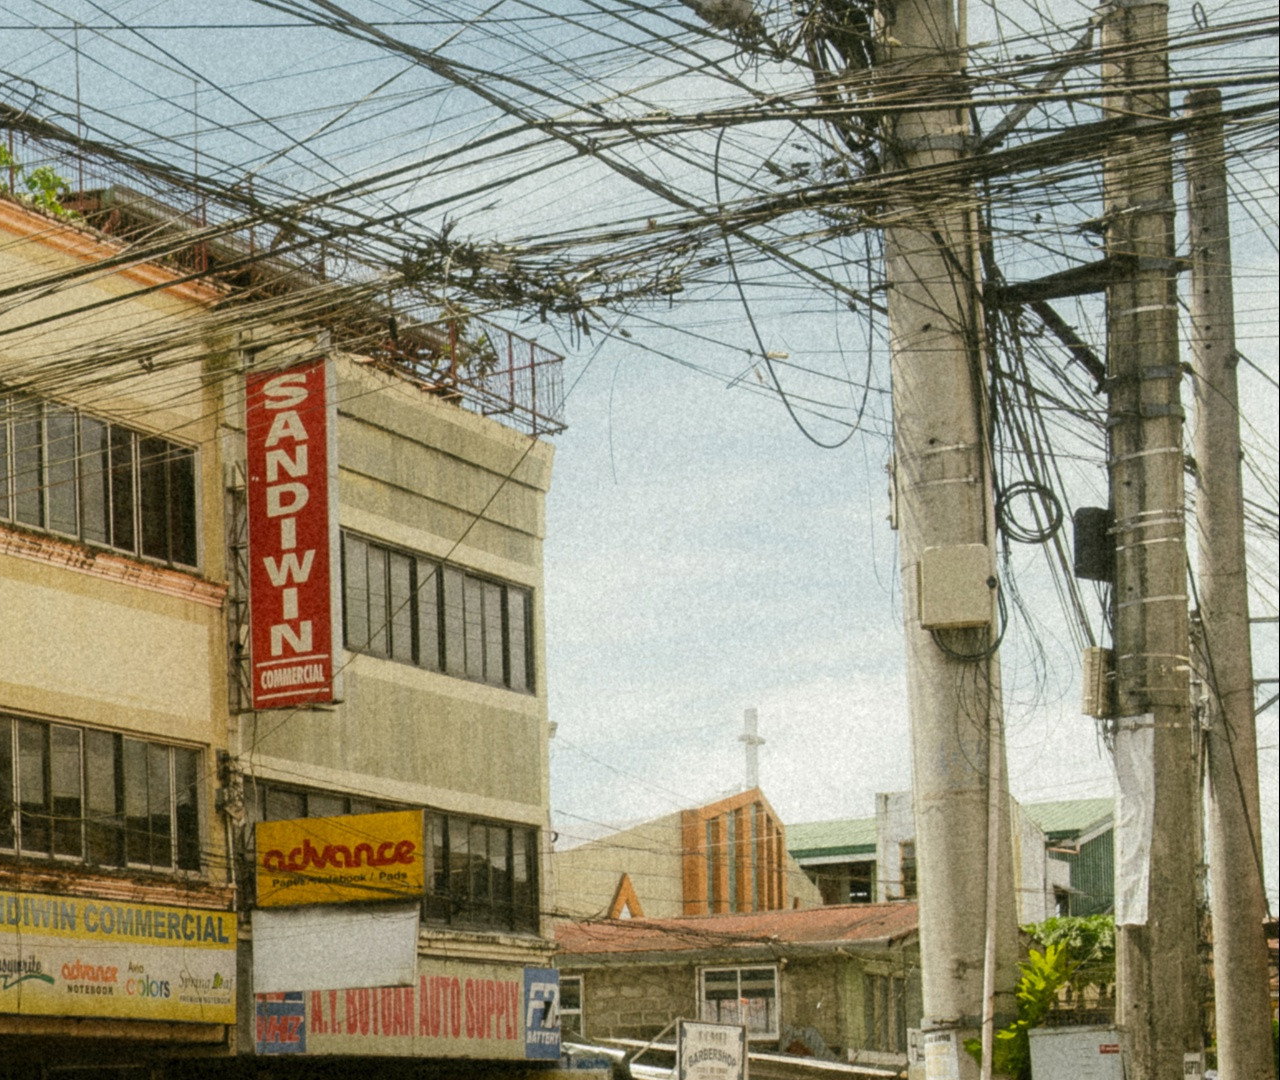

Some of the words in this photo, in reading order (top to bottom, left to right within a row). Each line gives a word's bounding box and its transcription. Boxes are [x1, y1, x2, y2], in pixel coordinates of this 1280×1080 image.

[262, 373, 316, 656] SANDIWIN
[260, 664, 325, 690] COMMERCIAL
[263, 838, 416, 873] advance
[378, 871, 407, 881] Pads
[83, 903, 230, 944] COMMERCIAL
[61, 959, 118, 982] advance
[67, 984, 113, 995] NOTEBOOK
[419, 975, 461, 1038] AUTO
[465, 978, 518, 1040] SUPPLY
[528, 1031, 559, 1045] BATTERY
[688, 1047, 737, 1068] BARBERSHOP
